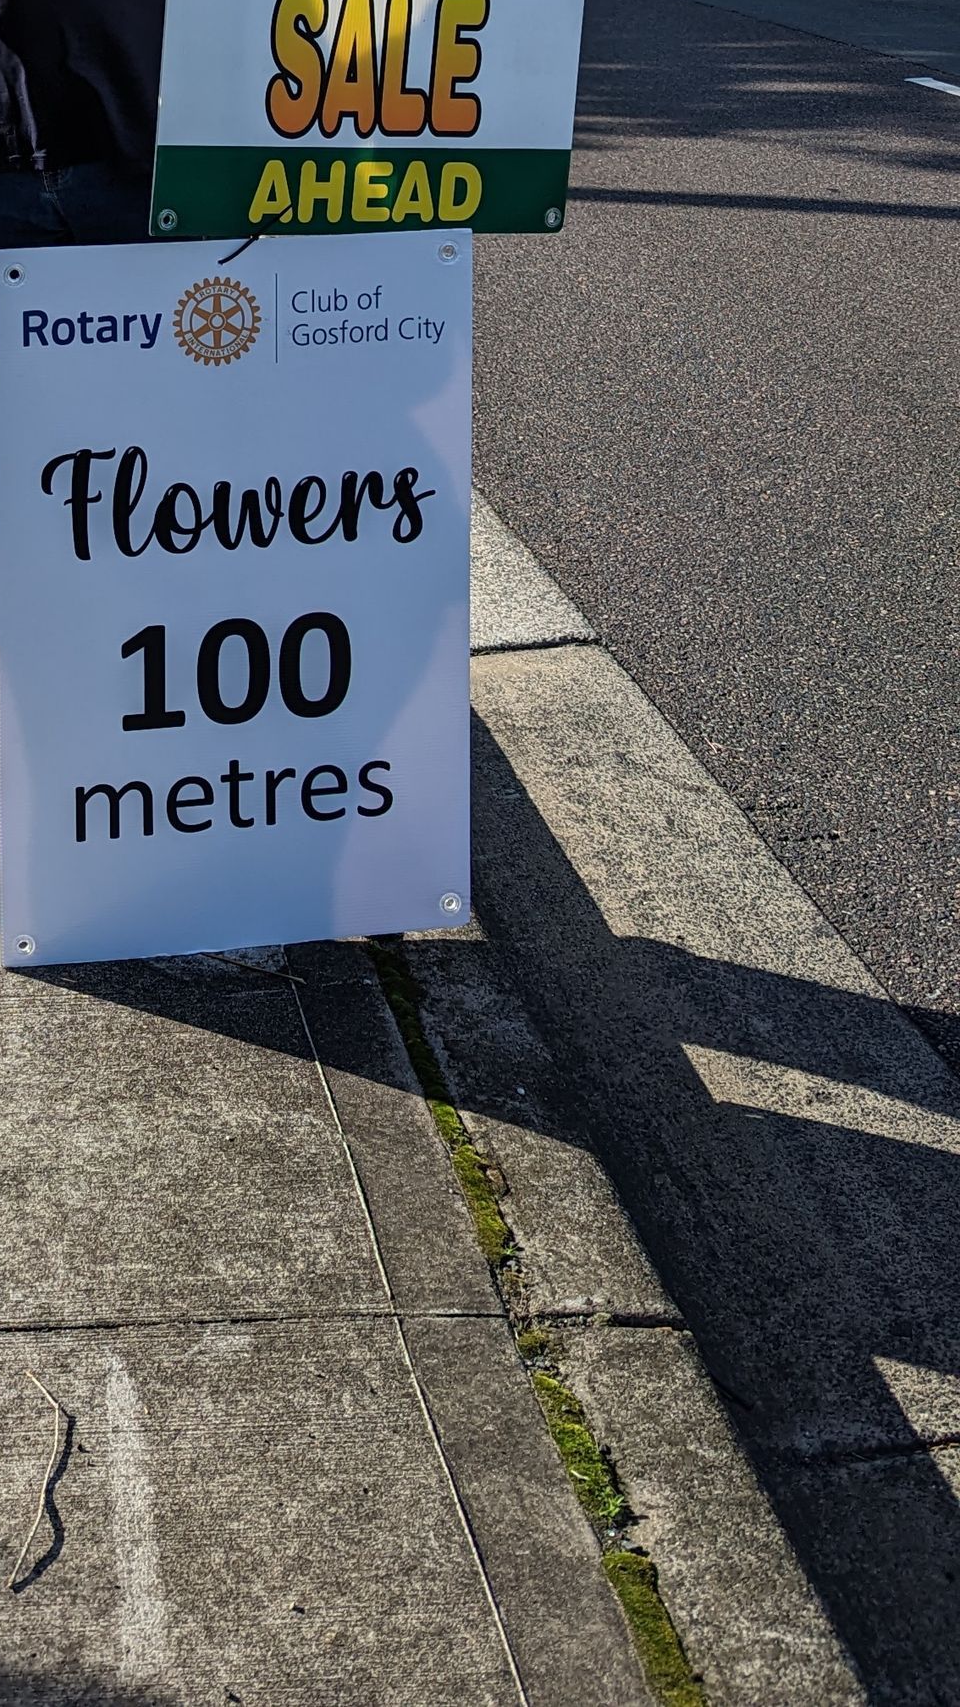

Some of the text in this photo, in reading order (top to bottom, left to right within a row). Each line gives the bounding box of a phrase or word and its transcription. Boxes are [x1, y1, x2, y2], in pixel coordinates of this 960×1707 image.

[248, 159, 483, 225] AHEAD
[198, 286, 236, 298] ROTARY
[291, 285, 383, 314] Club of
[22, 310, 163, 350] Rotary
[186, 332, 249, 358] INTERNATIONAL
[291, 316, 446, 347] Gosford City
[41, 446, 437, 562] Flowers
[120, 611, 353, 732] 100
[75, 759, 395, 843] metres
